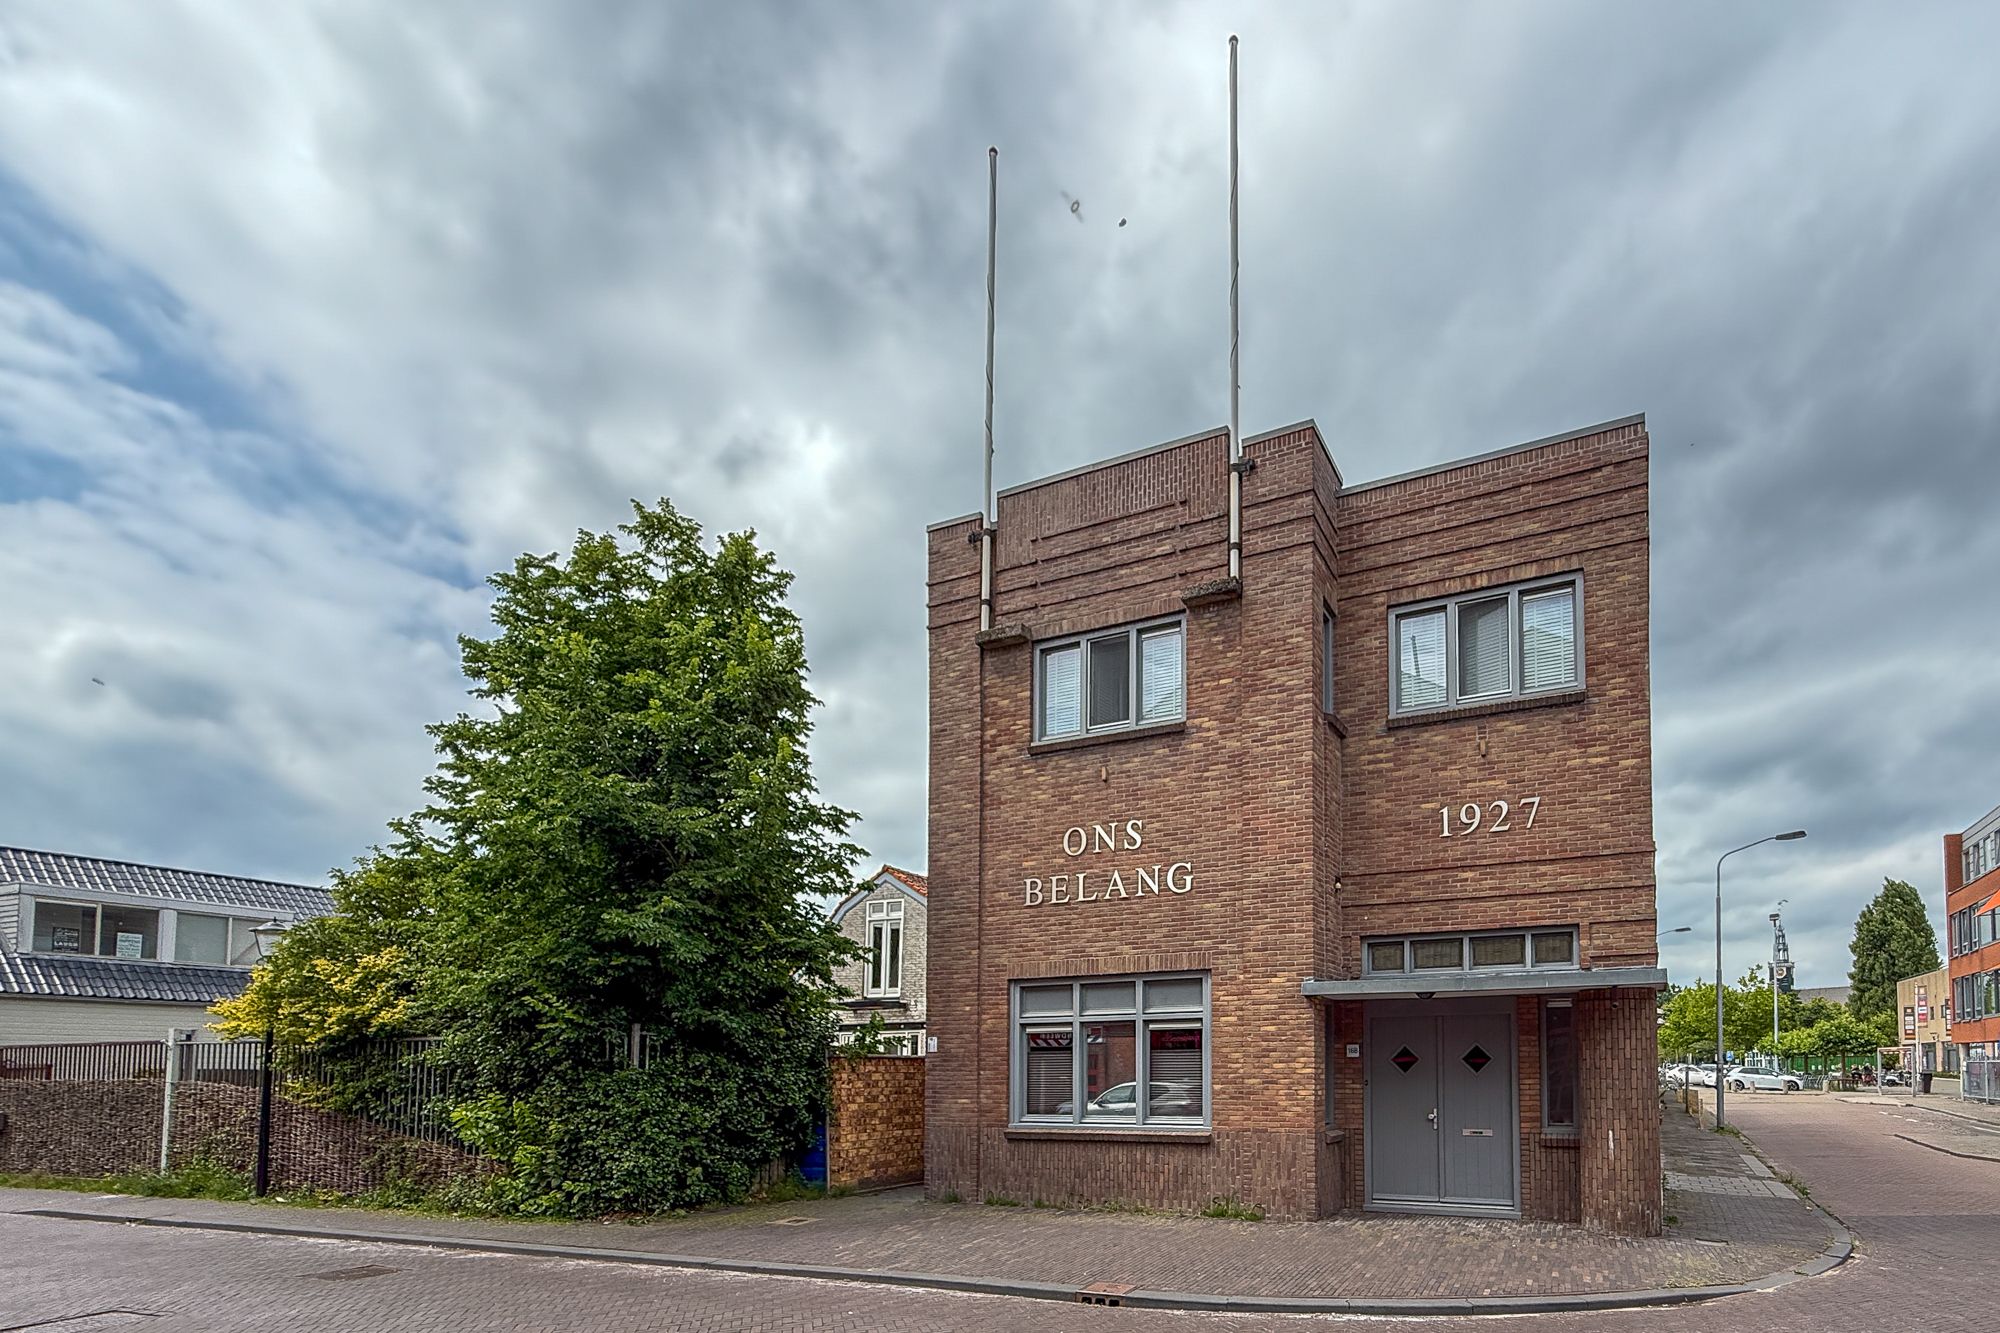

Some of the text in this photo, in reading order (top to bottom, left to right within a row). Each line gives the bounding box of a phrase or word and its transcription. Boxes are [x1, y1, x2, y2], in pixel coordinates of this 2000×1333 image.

[1062, 819, 1144, 857] ONS
[1438, 796, 1541, 838] 1927
[1023, 861, 1194, 907] BELANG
